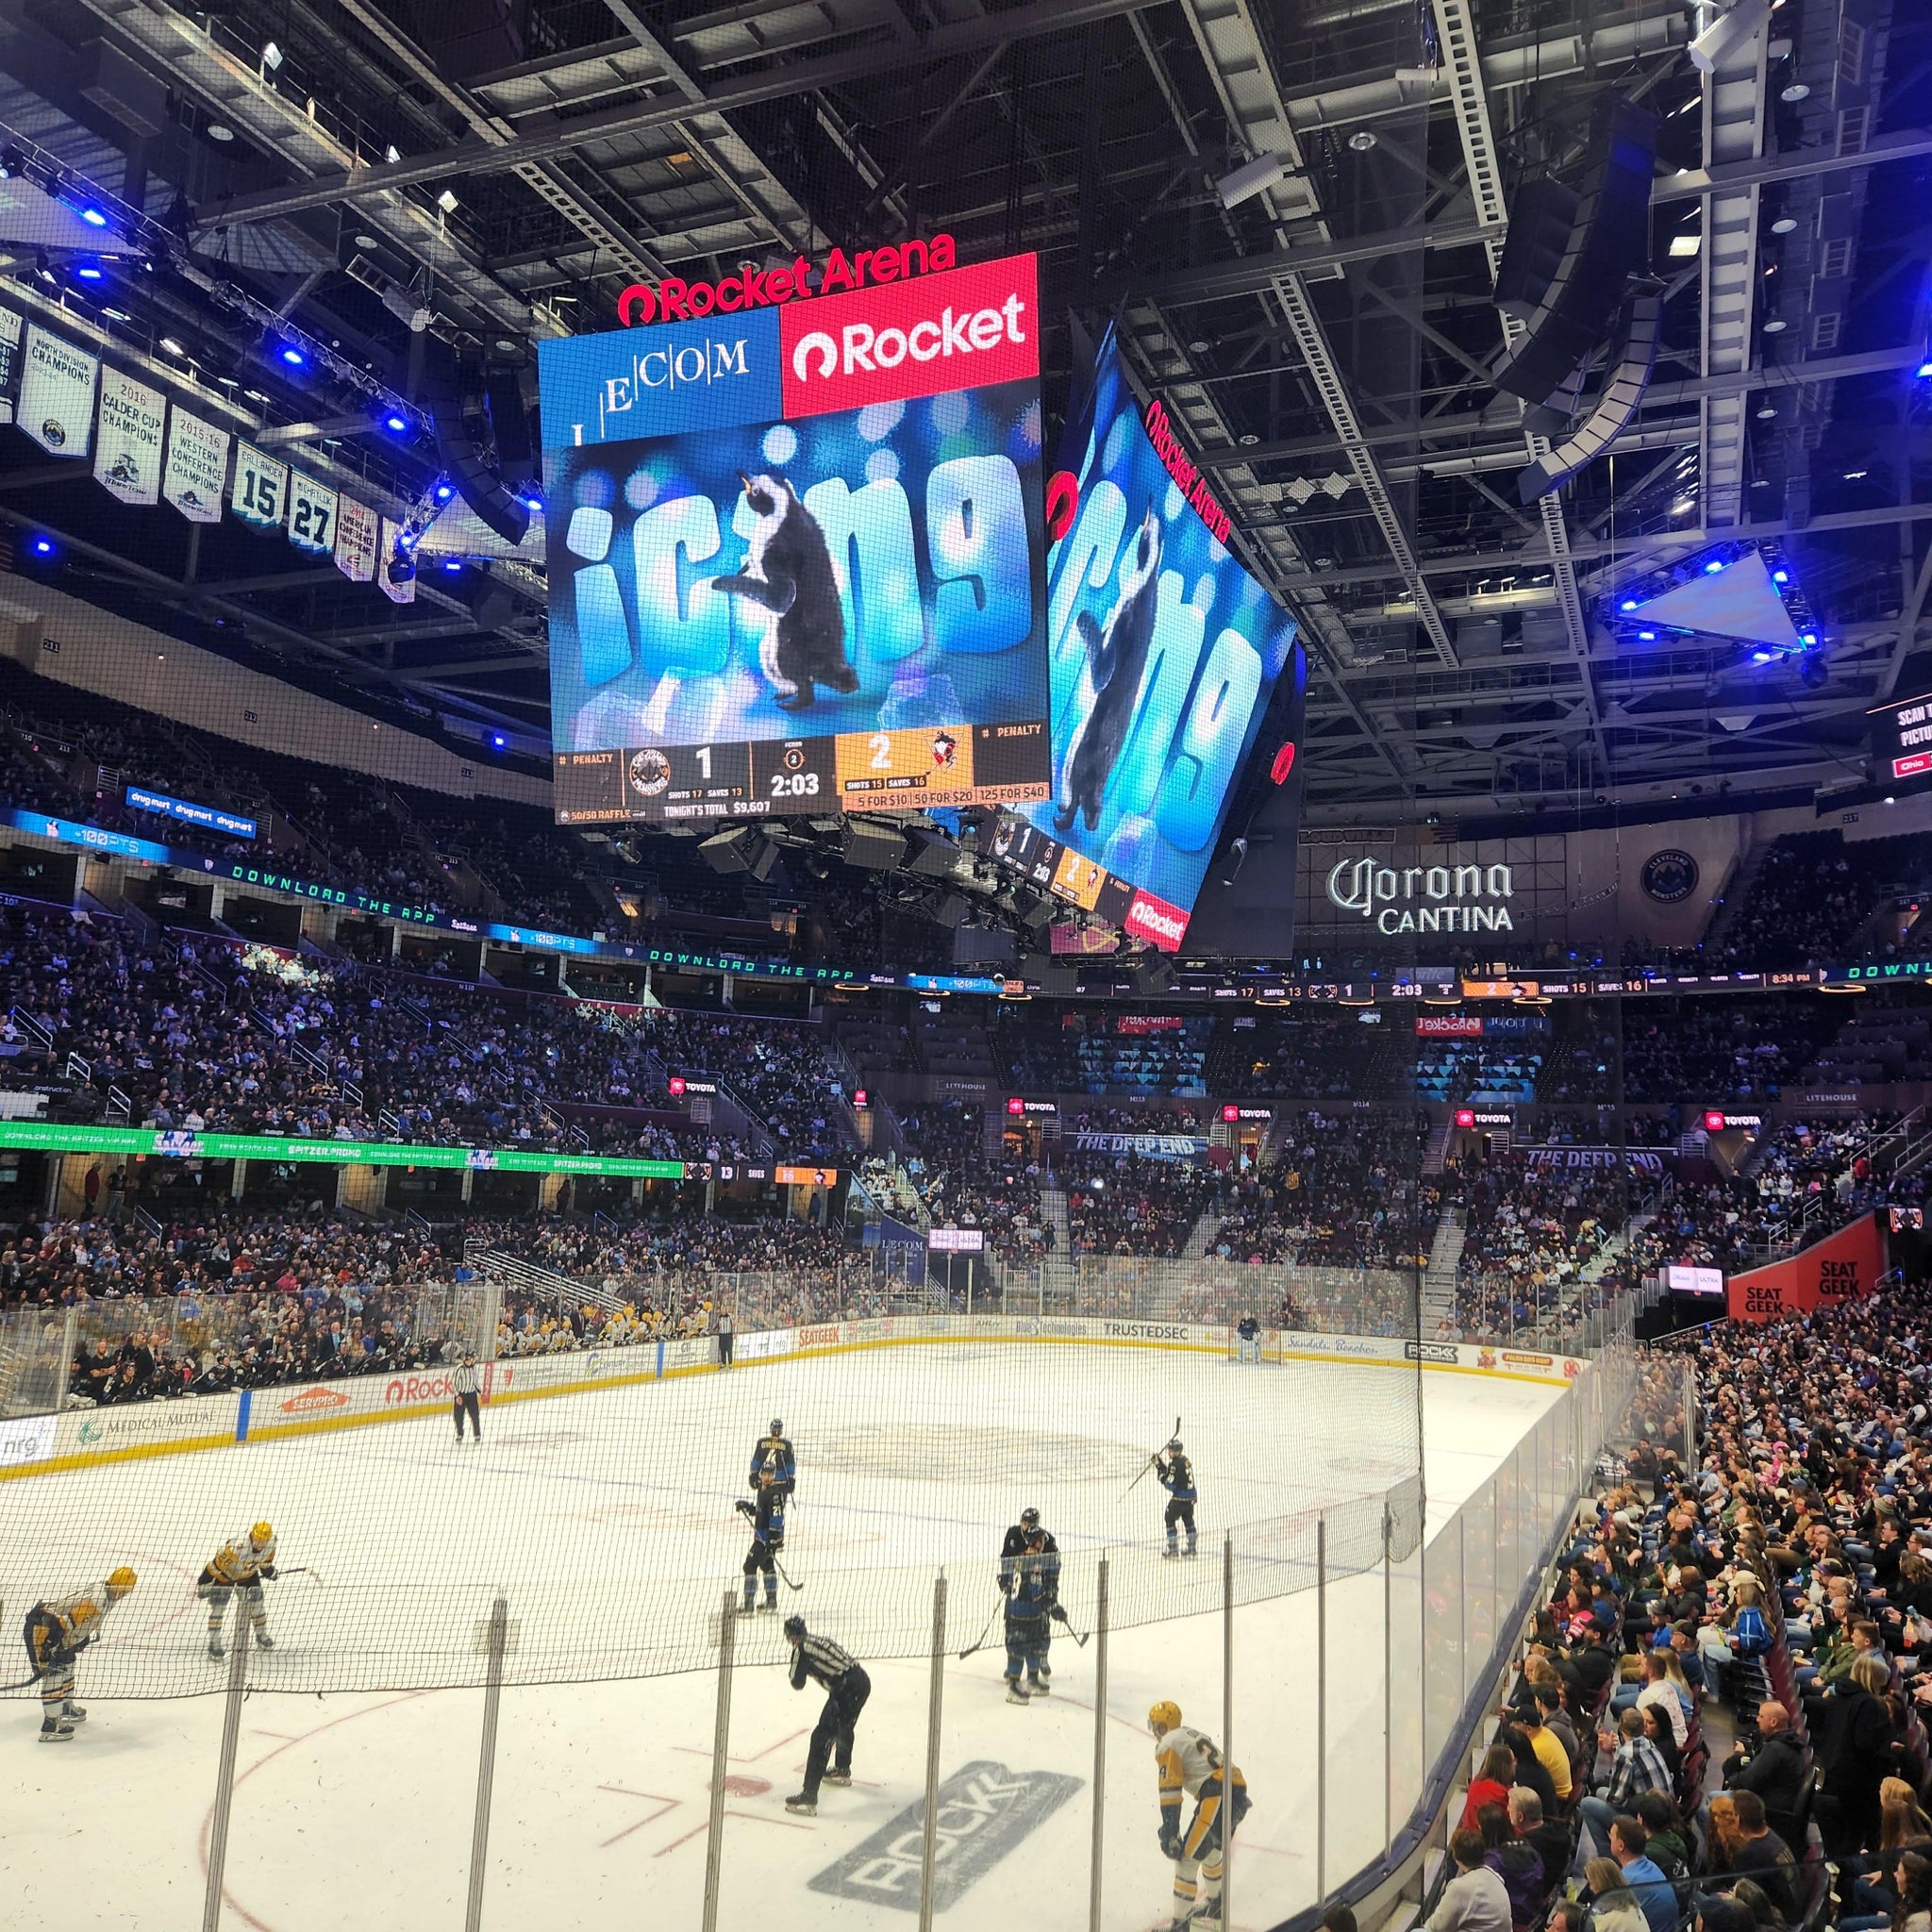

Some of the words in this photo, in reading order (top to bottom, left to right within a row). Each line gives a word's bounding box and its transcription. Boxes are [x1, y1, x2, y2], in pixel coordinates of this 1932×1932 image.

[661, 255, 812, 323] Rocket
[821, 234, 957, 294] Arena
[843, 292, 1025, 375] Rocket
[36, 338, 57, 355] NORTH
[58, 350, 89, 372] DIVISION
[32, 346, 90, 385] CHAMPIONS
[121, 384, 147, 407] 2016
[103, 392, 140, 421] CALDER
[142, 413, 161, 431] CUP
[103, 409, 158, 446] CHAMPIONS
[180, 435, 218, 464] WESTERN
[172, 447, 223, 481] CONFERENCE
[242, 451, 283, 479] CALLANDER
[173, 461, 219, 494] CHAMPIONS
[1151, 412, 1197, 498] Rocket
[1191, 476, 1231, 544] Arena
[243, 470, 277, 518] 15
[293, 497, 329, 544] 27
[566, 455, 1033, 688] icng
[44, 640, 59, 653] 211
[1897, 710, 1925, 726] SCAN
[997, 724, 1041, 738] PENALTY
[574, 754, 613, 765] PENALTY
[791, 755, 798, 764] 2
[869, 734, 892, 769] 2
[696, 746, 711, 779] 1
[771, 774, 820, 797] 2:03
[846, 781, 870, 790] SHOTS
[872, 780, 882, 789] 15
[889, 778, 911, 787] SAVES
[914, 777, 924, 786] 16
[668, 791, 691, 799] SHOTS
[691, 790, 703, 798] 17
[708, 789, 729, 797] SAVES
[732, 788, 742, 796] 13
[858, 796, 865, 807] 5
[868, 796, 887, 807] FOR
[890, 794, 908, 807] $10
[915, 793, 928, 805] 50
[930, 792, 950, 804] FOR
[953, 791, 973, 803] $20
[981, 790, 998, 801] 125
[1001, 789, 1021, 800] FOR
[1024, 786, 1044, 798] $40
[571, 810, 596, 820] 50/50
[599, 809, 631, 819] RAFFLE
[664, 805, 703, 817] TONIGHT'S
[706, 804, 728, 815] TOTAL
[733, 801, 771, 814] $9,607
[1019, 827, 1032, 853] 1
[1033, 862, 1051, 883] 2:03
[1065, 856, 1080, 881] 2
[232, 866, 345, 903] DOWNLOAD
[358, 896, 390, 914] THE
[402, 907, 435, 924] APP
[1325, 856, 1515, 916] Corona
[1143, 904, 1185, 941] Rocket
[1378, 906, 1514, 935] CANTINA
[650, 950, 755, 972] DOWNLOAD
[769, 964, 805, 976] THE
[817, 969, 854, 980] APP
[1572, 983, 1587, 992] 15
[1626, 981, 1641, 991] 16
[1773, 974, 1793, 984] 8:34
[1796, 974, 1809, 982] PM
[1241, 988, 1255, 997] 17
[1289, 988, 1302, 996] 13
[1344, 984, 1353, 997] 1
[1391, 984, 1423, 996] 2:03
[1488, 983, 1496, 996] 2
[686, 1083, 716, 1092] TOYOTA
[1024, 1103, 1056, 1111] TOYOTA
[1240, 1109, 1271, 1118] TOYOTA
[1474, 1114, 1510, 1123] TOYOTA
[1724, 1116, 1761, 1126] TOYOTA
[1076, 1135, 1108, 1150] THE
[1159, 1138, 1195, 1155] END
[1527, 1150, 1563, 1166] THE
[1567, 1152, 1617, 1169] DEEP
[722, 1167, 733, 1179] 13
[748, 1169, 765, 1178] SAVES
[882, 1239, 924, 1251] LECOM
[1821, 1260, 1858, 1279] SEAT
[1746, 1287, 1782, 1301] SEAT
[1819, 1278, 1860, 1296] GEEK
[1745, 1299, 1784, 1314] GEEK
[799, 1326, 840, 1347] SEATGEEK
[1016, 1322, 1032, 1334] Blue
[1040, 1321, 1086, 1336] Technologies
[1104, 1324, 1189, 1340] TRUSTEDSEC
[1408, 1345, 1456, 1358] ROCK
[406, 1373, 455, 1403] Rock
[292, 1394, 339, 1409] SERVPRO
[108, 1417, 165, 1433] MEDICAL
[167, 1411, 216, 1426] MUTUAL
[4, 1436, 39, 1457] nrg
[773, 1506, 781, 1517] 21
